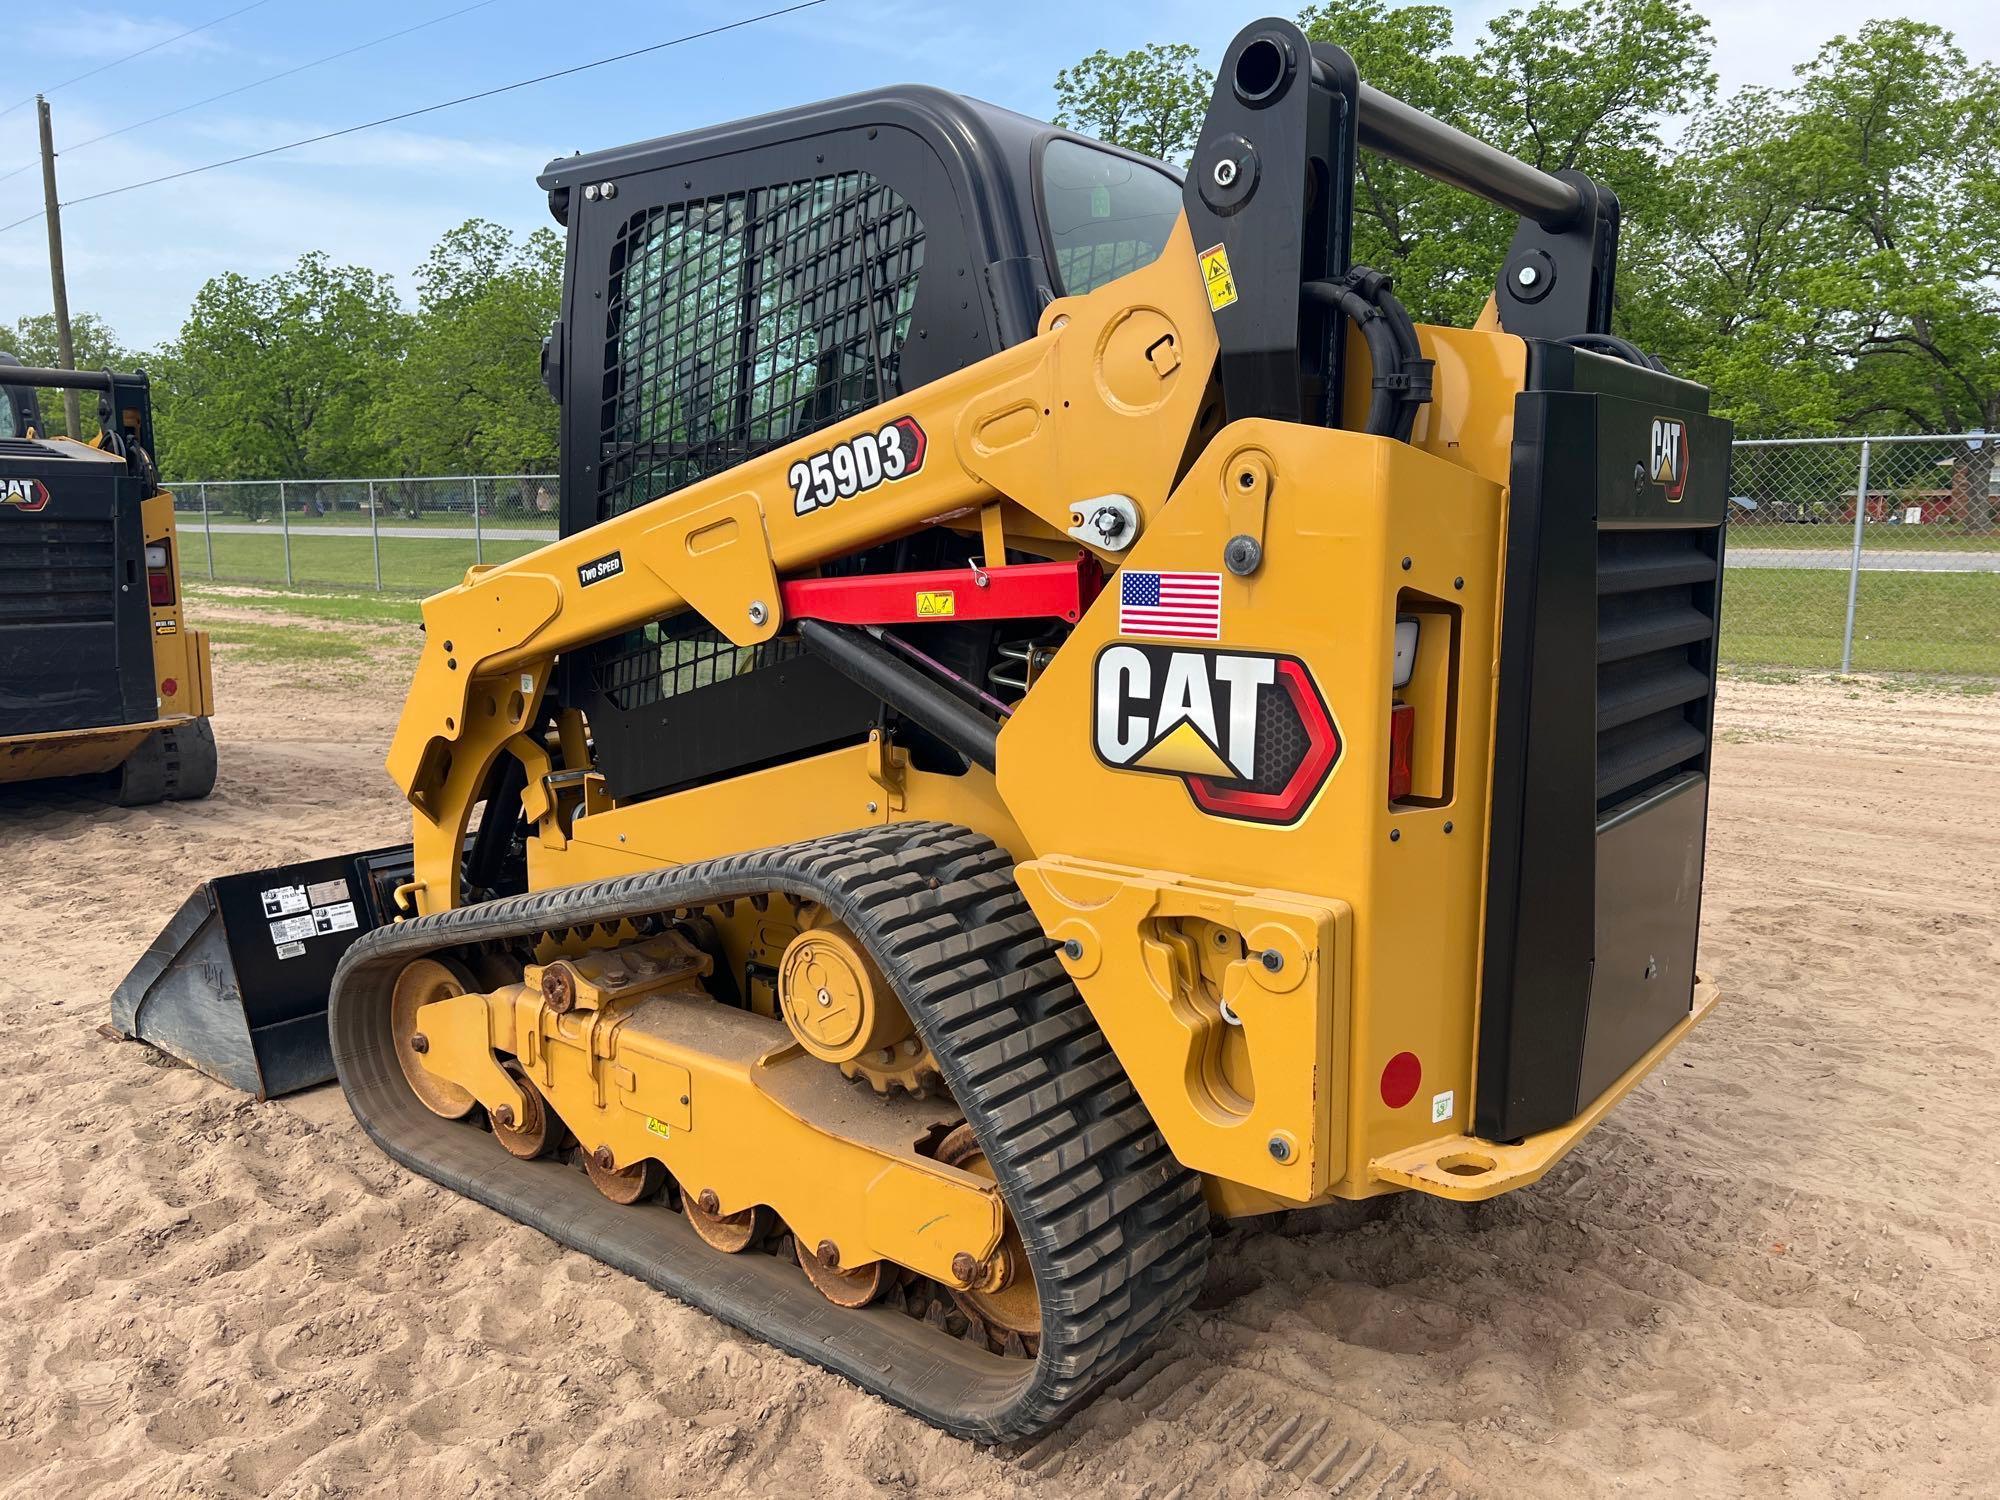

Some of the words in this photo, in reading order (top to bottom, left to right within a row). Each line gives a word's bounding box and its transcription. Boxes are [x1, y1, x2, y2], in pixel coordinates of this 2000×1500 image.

[789, 425, 906, 513] 259D3
[1651, 420, 1681, 481] CAT
[0, 479, 34, 503] CAT
[1097, 645, 1276, 781] CAT
